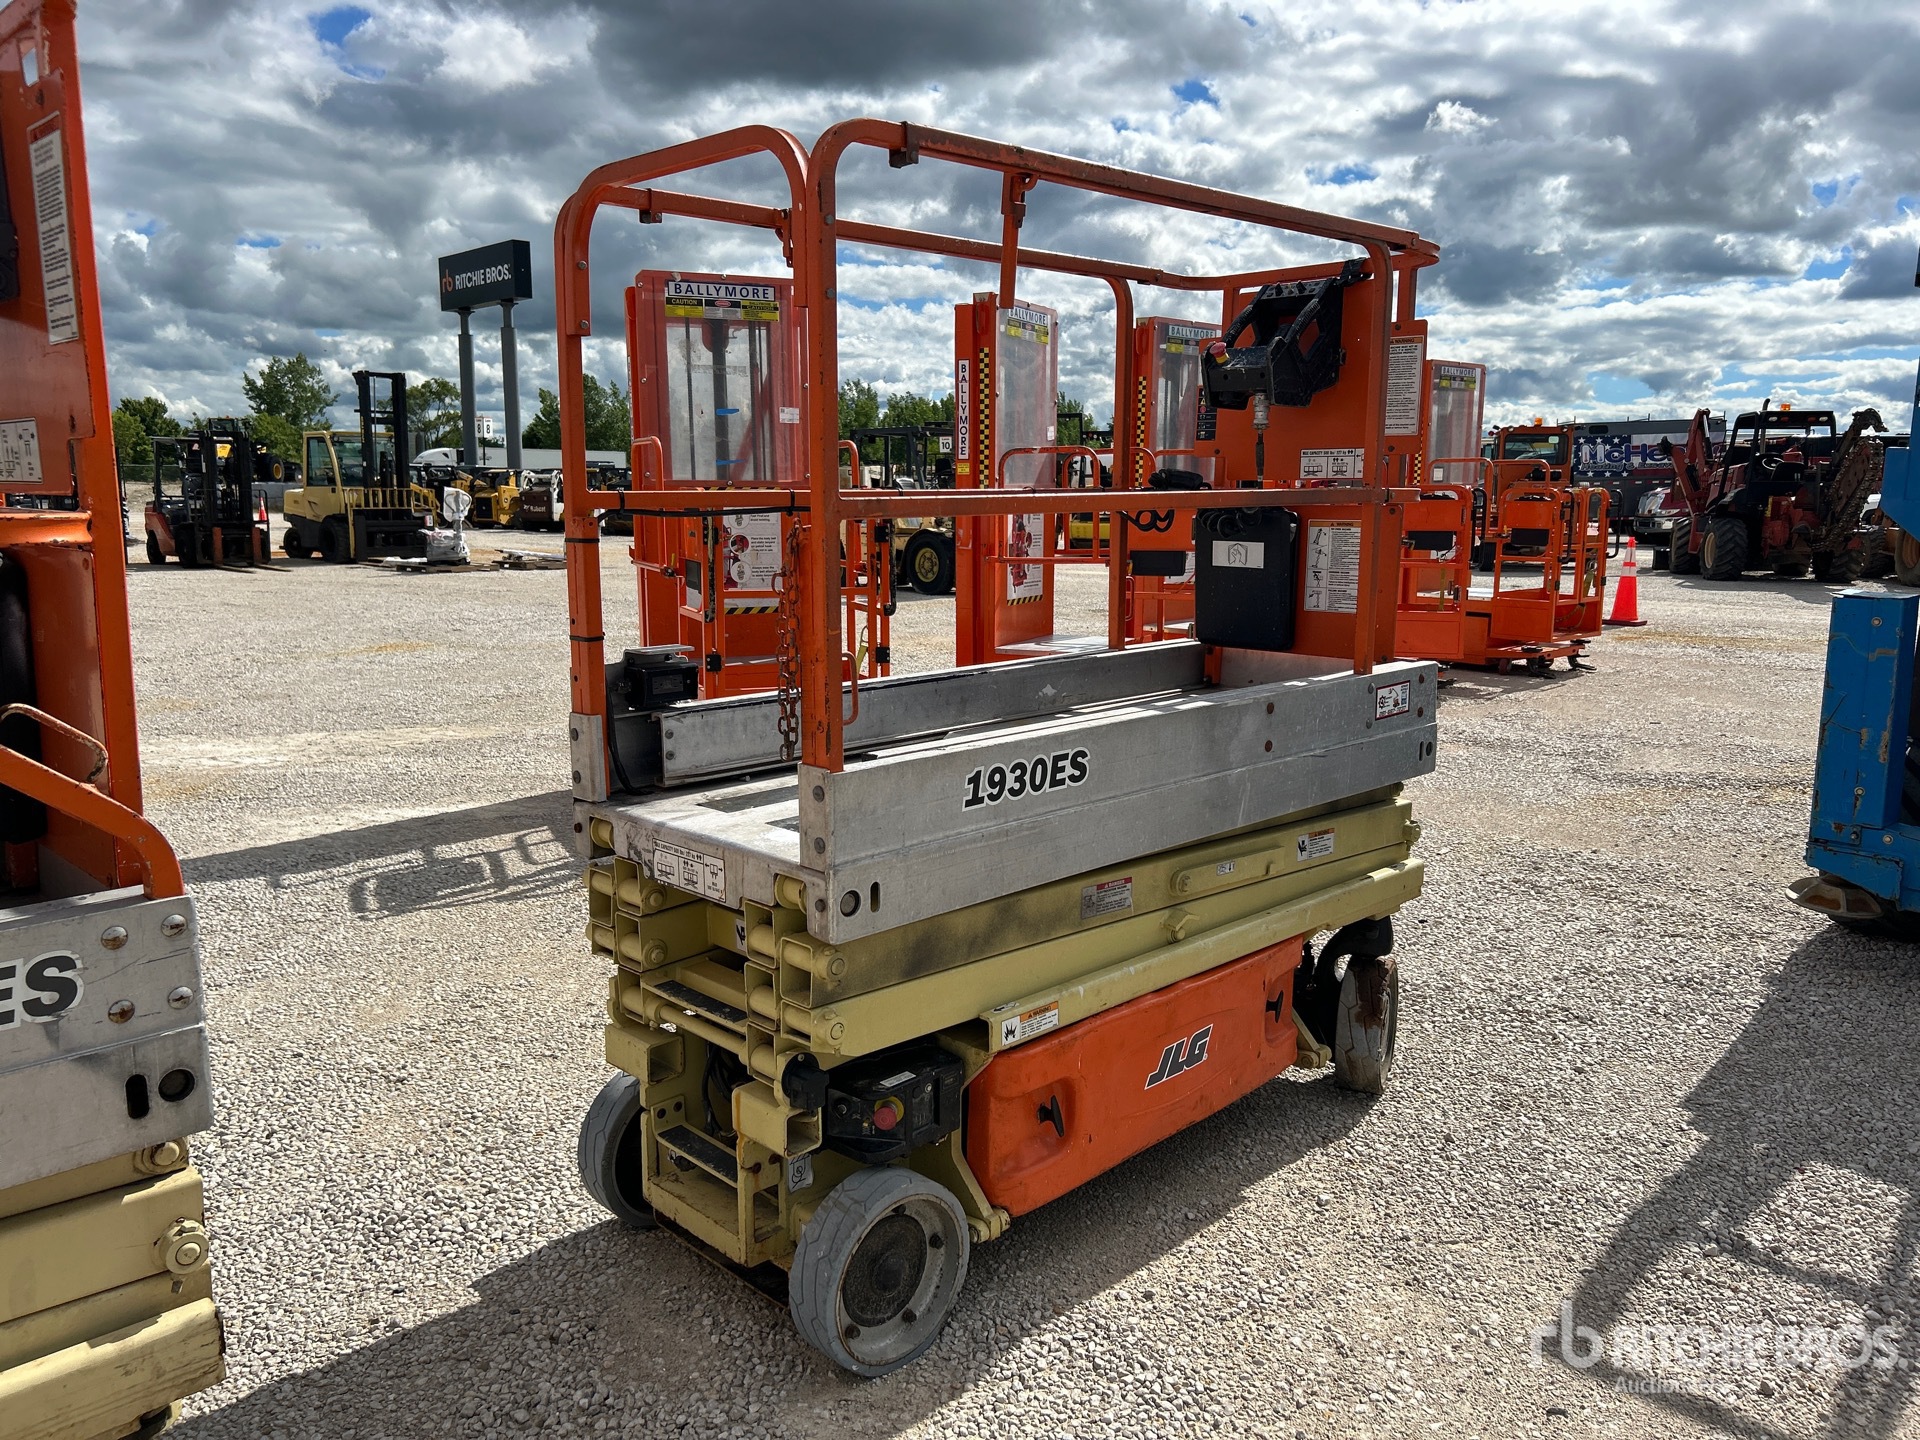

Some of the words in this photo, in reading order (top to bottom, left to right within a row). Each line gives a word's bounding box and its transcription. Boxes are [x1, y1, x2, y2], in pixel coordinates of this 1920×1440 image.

[455, 270, 485, 290] RITCHIE
[486, 264, 512, 284] BROS.
[674, 283, 769, 300] BALLYMORE
[672, 298, 697, 306] CAUTION
[1010, 307, 1046, 325] BALLYMORE
[1171, 326, 1213, 339] BALLYMORE
[1443, 366, 1474, 377] BALLYMORE
[960, 364, 968, 455] BALLYMORE
[486, 424, 490, 434] 8
[942, 442, 950, 450] 10
[1580, 443, 1673, 464] McHe
[963, 748, 1089, 810] 1930ES
[1033, 1005, 1052, 1016] WARNING
[1144, 1024, 1213, 1090] JLG
